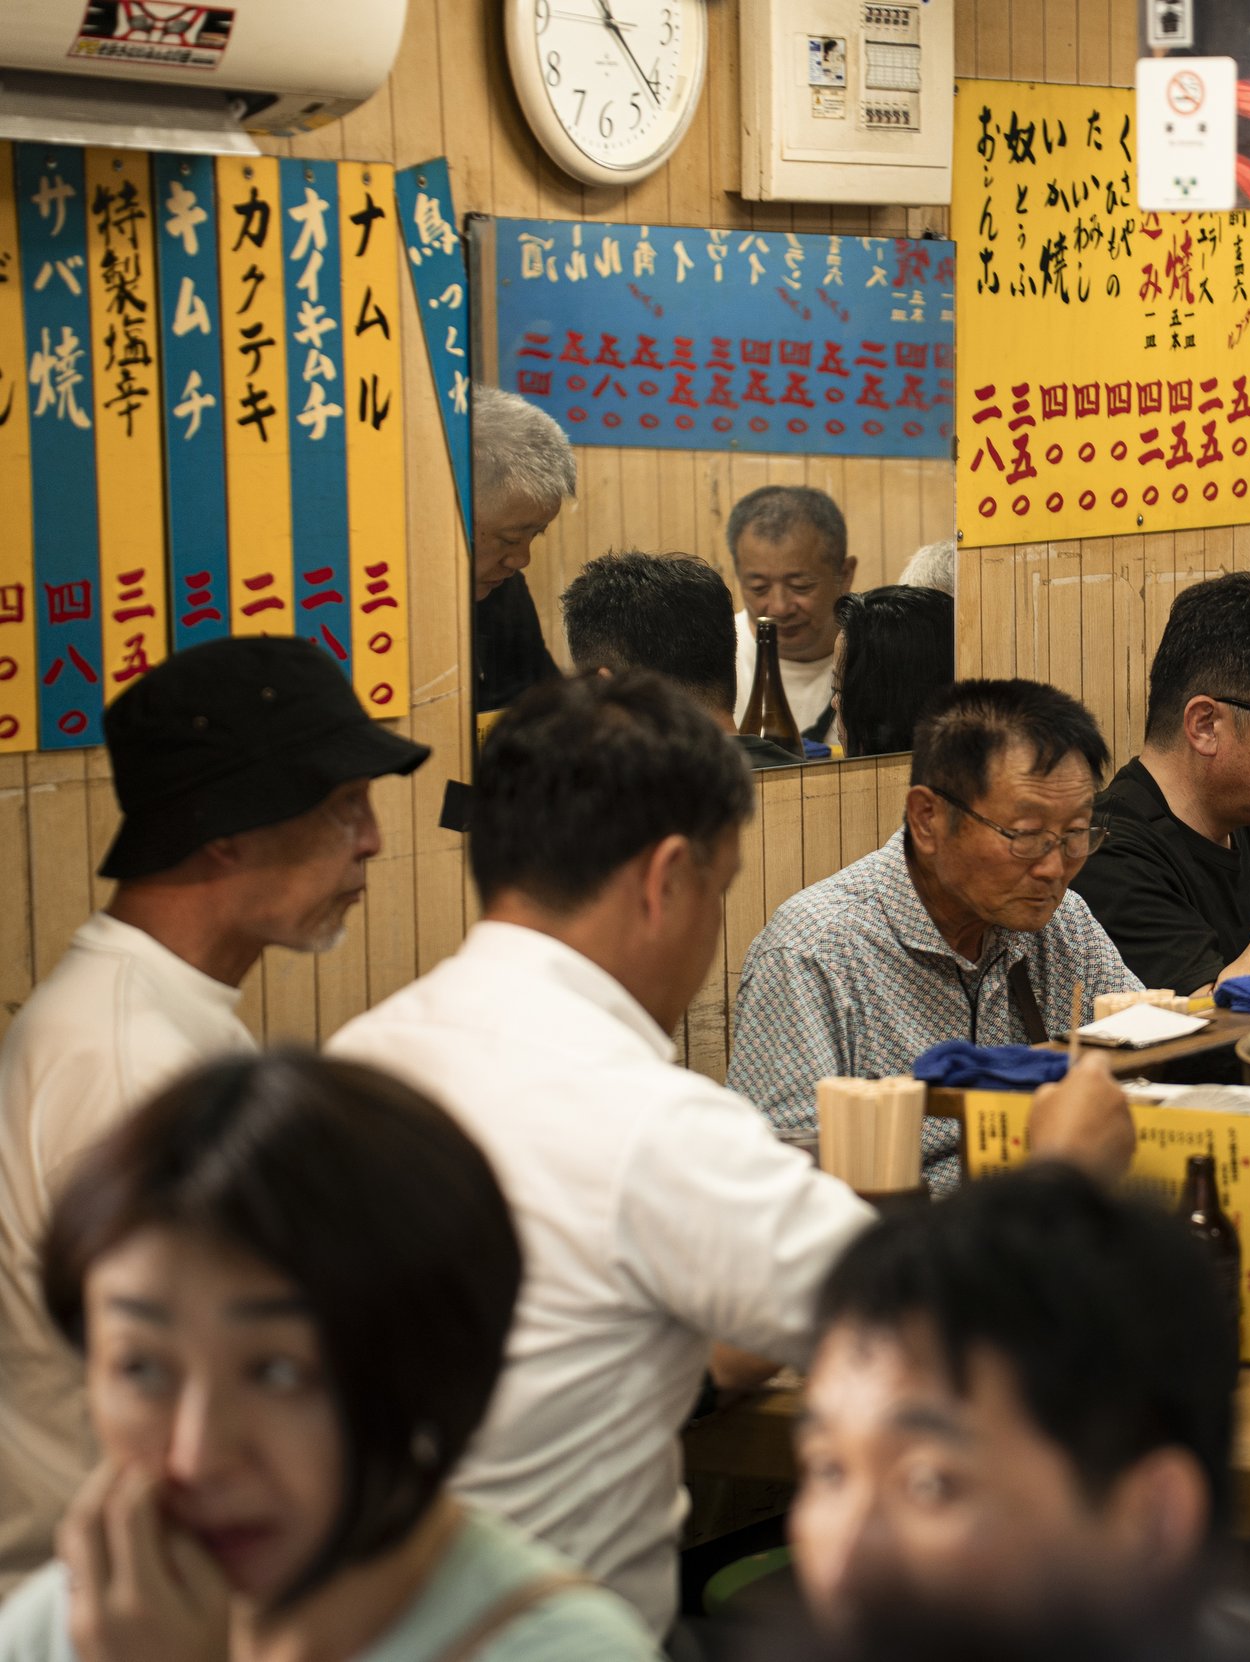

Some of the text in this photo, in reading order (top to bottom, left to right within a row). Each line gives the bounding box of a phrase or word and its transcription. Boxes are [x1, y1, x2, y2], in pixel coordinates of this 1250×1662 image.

[546, 50, 561, 87] 8
[660, 8, 673, 46] 3
[573, 89, 587, 126] 7
[598, 100, 613, 138] 6
[629, 92, 642, 130] 5
[92, 179, 153, 437] 特製塩辛
[165, 179, 216, 441] キムチ
[232, 186, 278, 443] カクテキ
[288, 187, 343, 441] オイキムチ
[1003, 110, 1037, 516] 奴とうふ 三五〇
[1040, 118, 1070, 512] いか焼 四〇〇
[30, 174, 98, 736] サバ焼 四八〇
[350, 192, 399, 706] ナムル 三〇〇
[970, 384, 1005, 518] 二八〇
[1073, 381, 1100, 510] 四〇〇
[1105, 380, 1131, 508] 四〇〇
[1136, 379, 1165, 506] 四二〇
[1165, 378, 1193, 503] 四五〇
[1196, 377, 1223, 501] 二五〇
